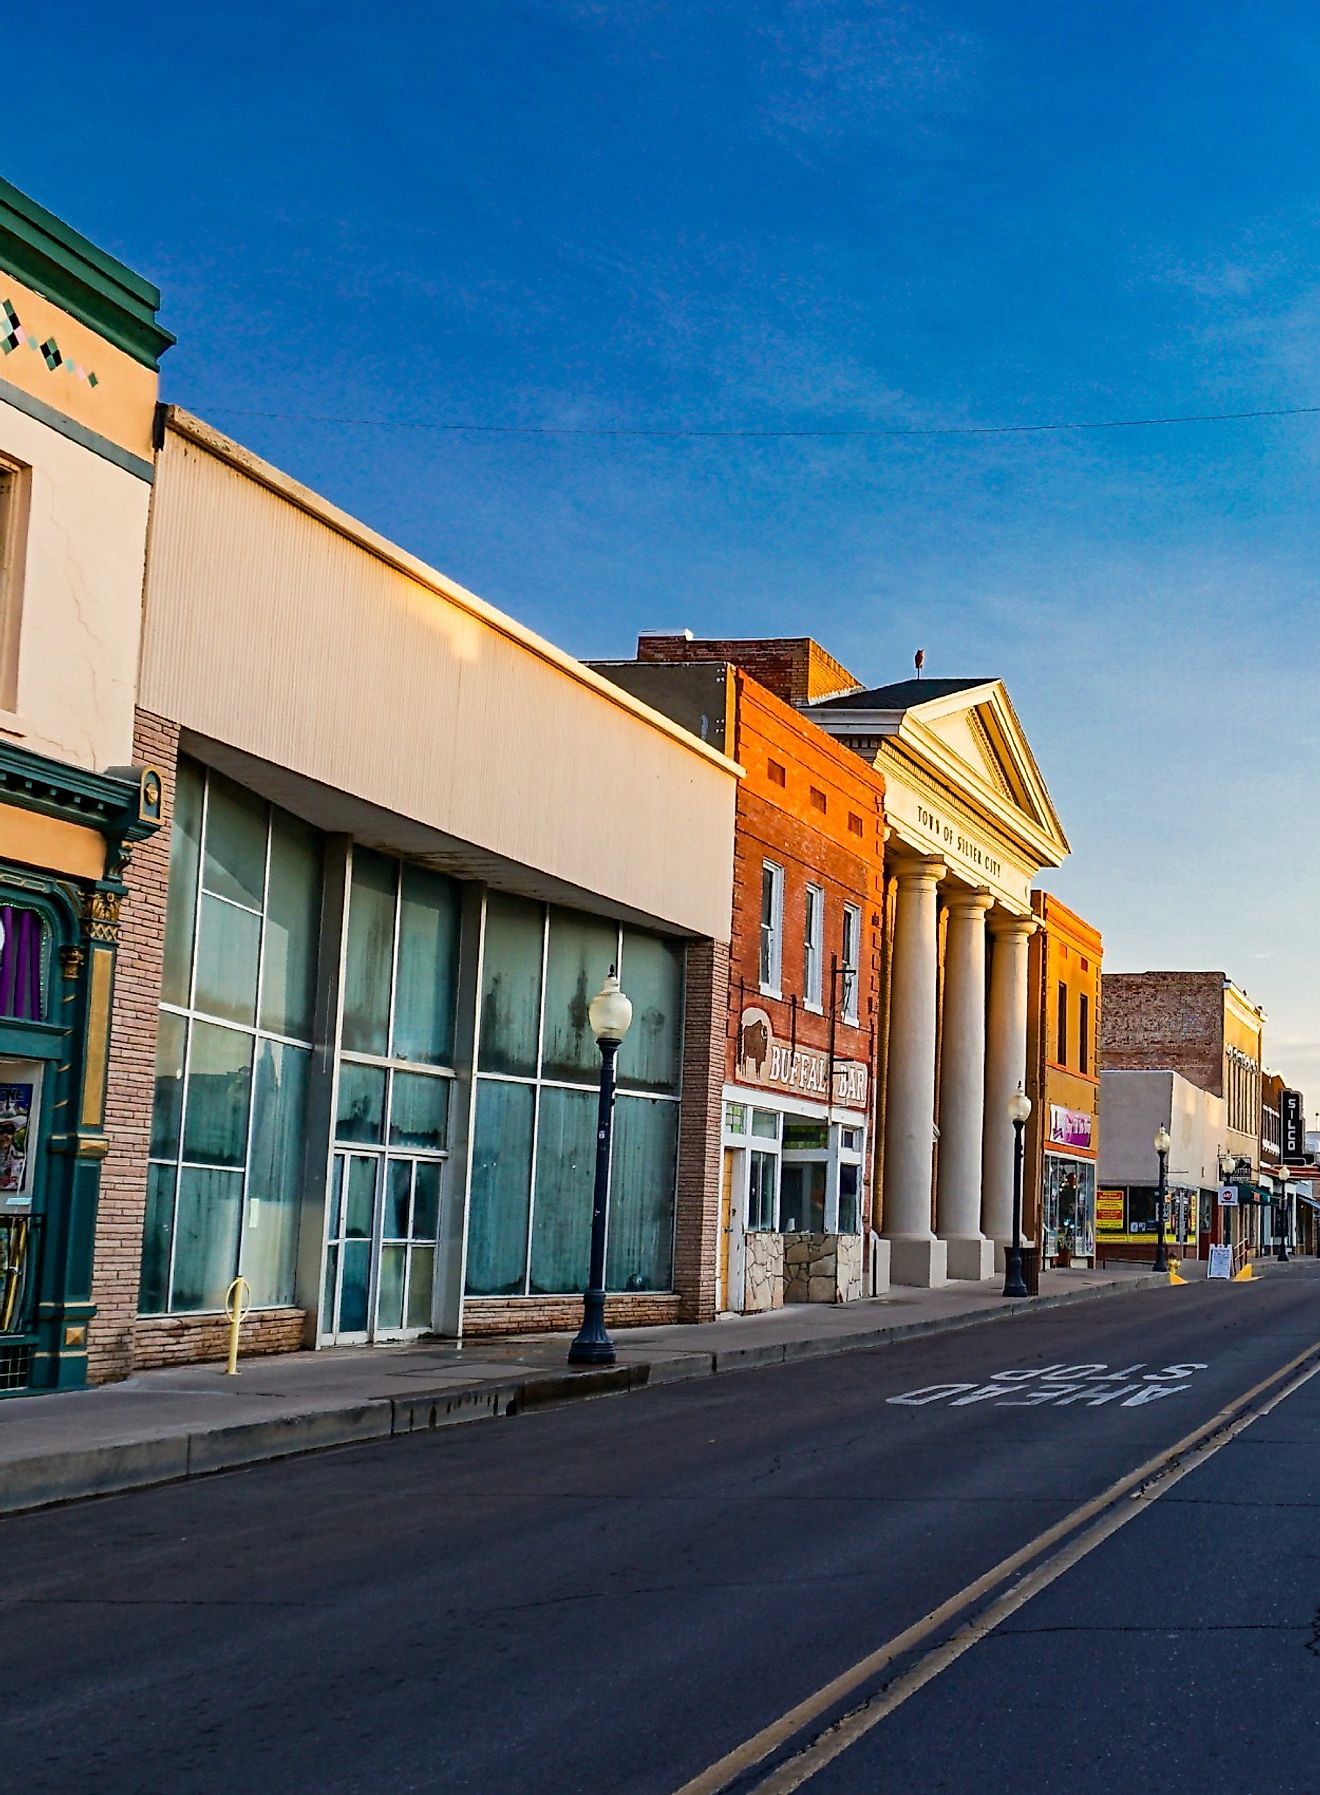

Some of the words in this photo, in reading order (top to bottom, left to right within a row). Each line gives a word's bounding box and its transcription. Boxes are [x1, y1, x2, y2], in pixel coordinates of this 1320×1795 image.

[917, 805, 940, 835] TOWN
[943, 826, 953, 845] OF
[957, 836, 982, 865] SILVER
[984, 855, 1001, 878] CITY
[769, 1044, 832, 1095] BUFFAL
[838, 1063, 865, 1102] BAR
[1287, 1098, 1297, 1151] SILCO
[885, 1383, 1193, 1407] AHEAD
[990, 1363, 1209, 1381] STOP
